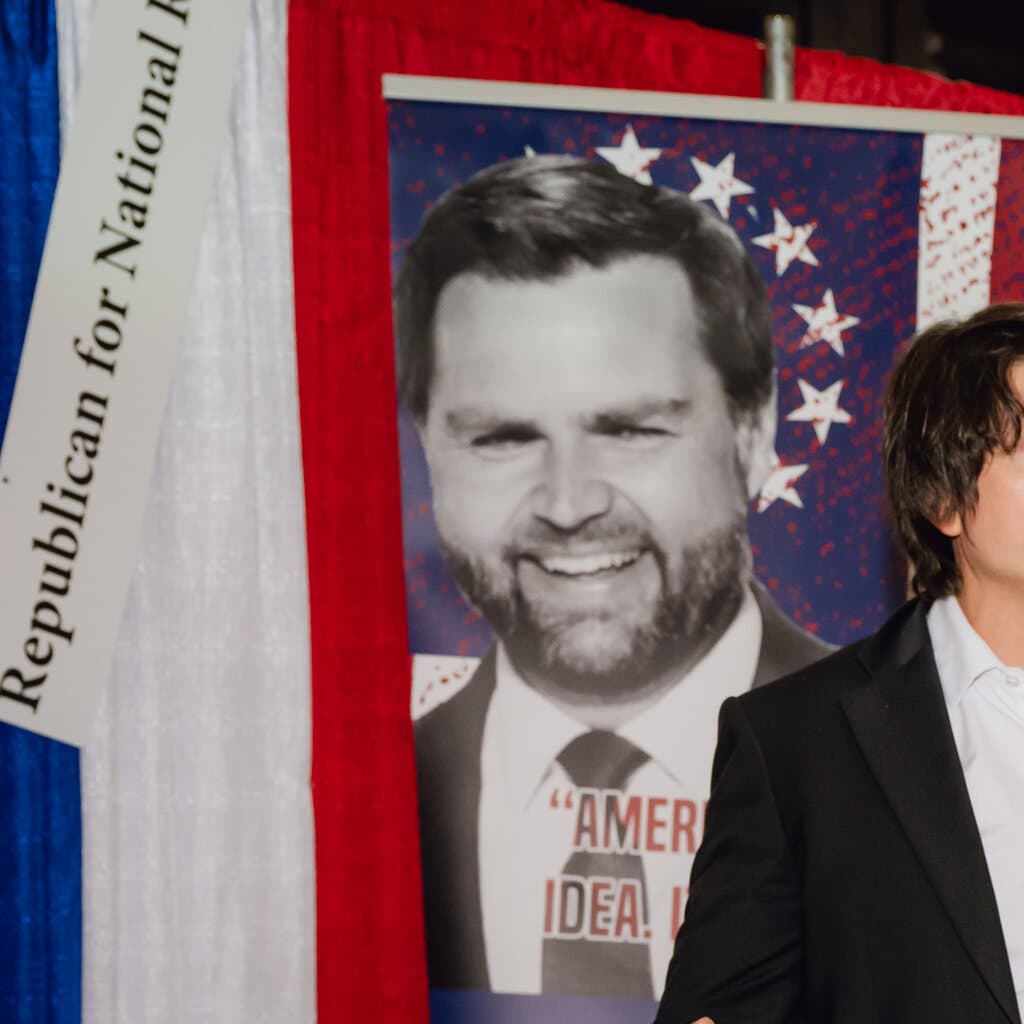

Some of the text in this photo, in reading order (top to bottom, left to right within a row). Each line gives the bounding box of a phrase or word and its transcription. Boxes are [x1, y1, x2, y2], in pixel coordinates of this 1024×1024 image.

[94, 30, 182, 279] National
[73, 287, 128, 379] for
[0, 390, 109, 714] Republican
[550, 789, 712, 854] “AMER
[544, 879, 652, 939] IDEA.
